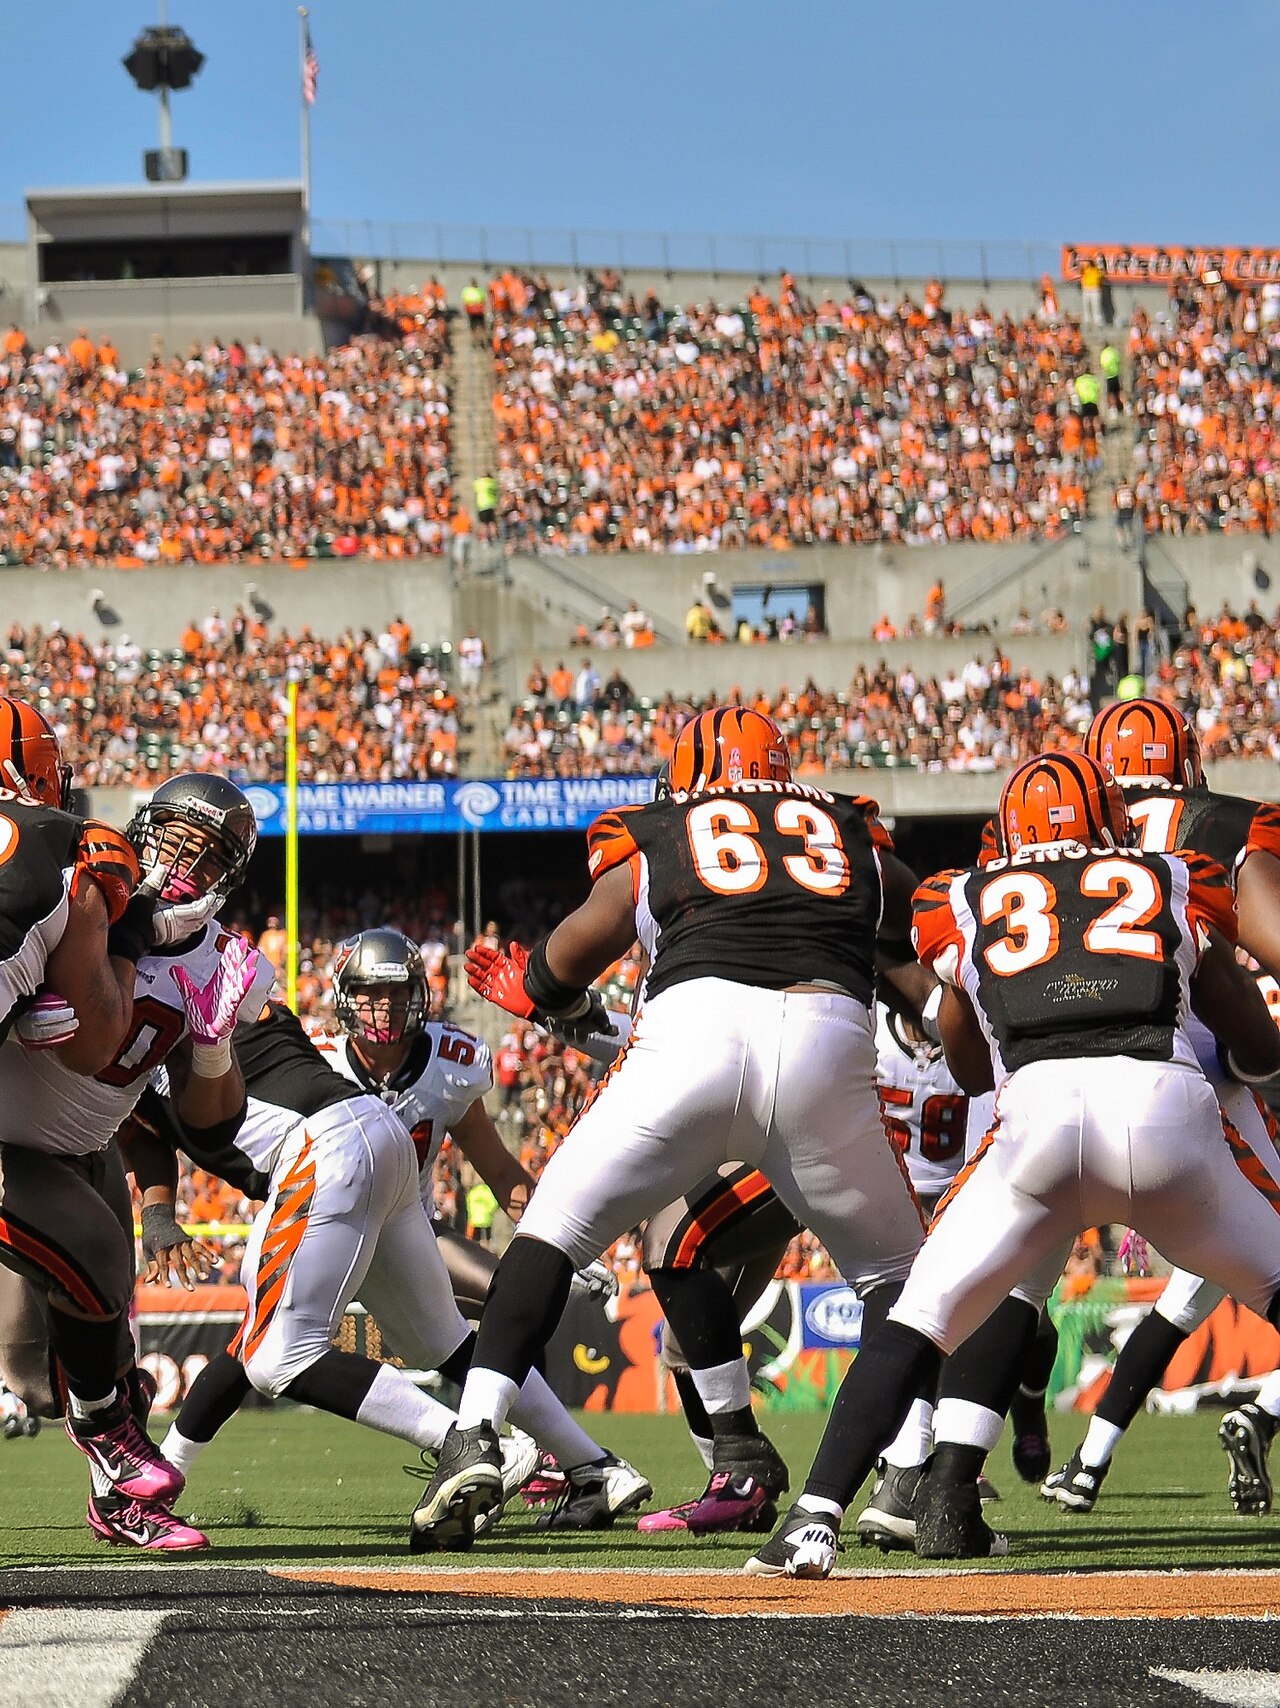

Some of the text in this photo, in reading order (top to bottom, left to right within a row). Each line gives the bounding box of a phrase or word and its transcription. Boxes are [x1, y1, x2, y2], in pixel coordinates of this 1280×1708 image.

[343, 783, 446, 808] WARNER
[500, 781, 561, 804] TIME
[500, 805, 578, 827] CABLE
[686, 798, 851, 897] 63
[980, 857, 1165, 977] 32
